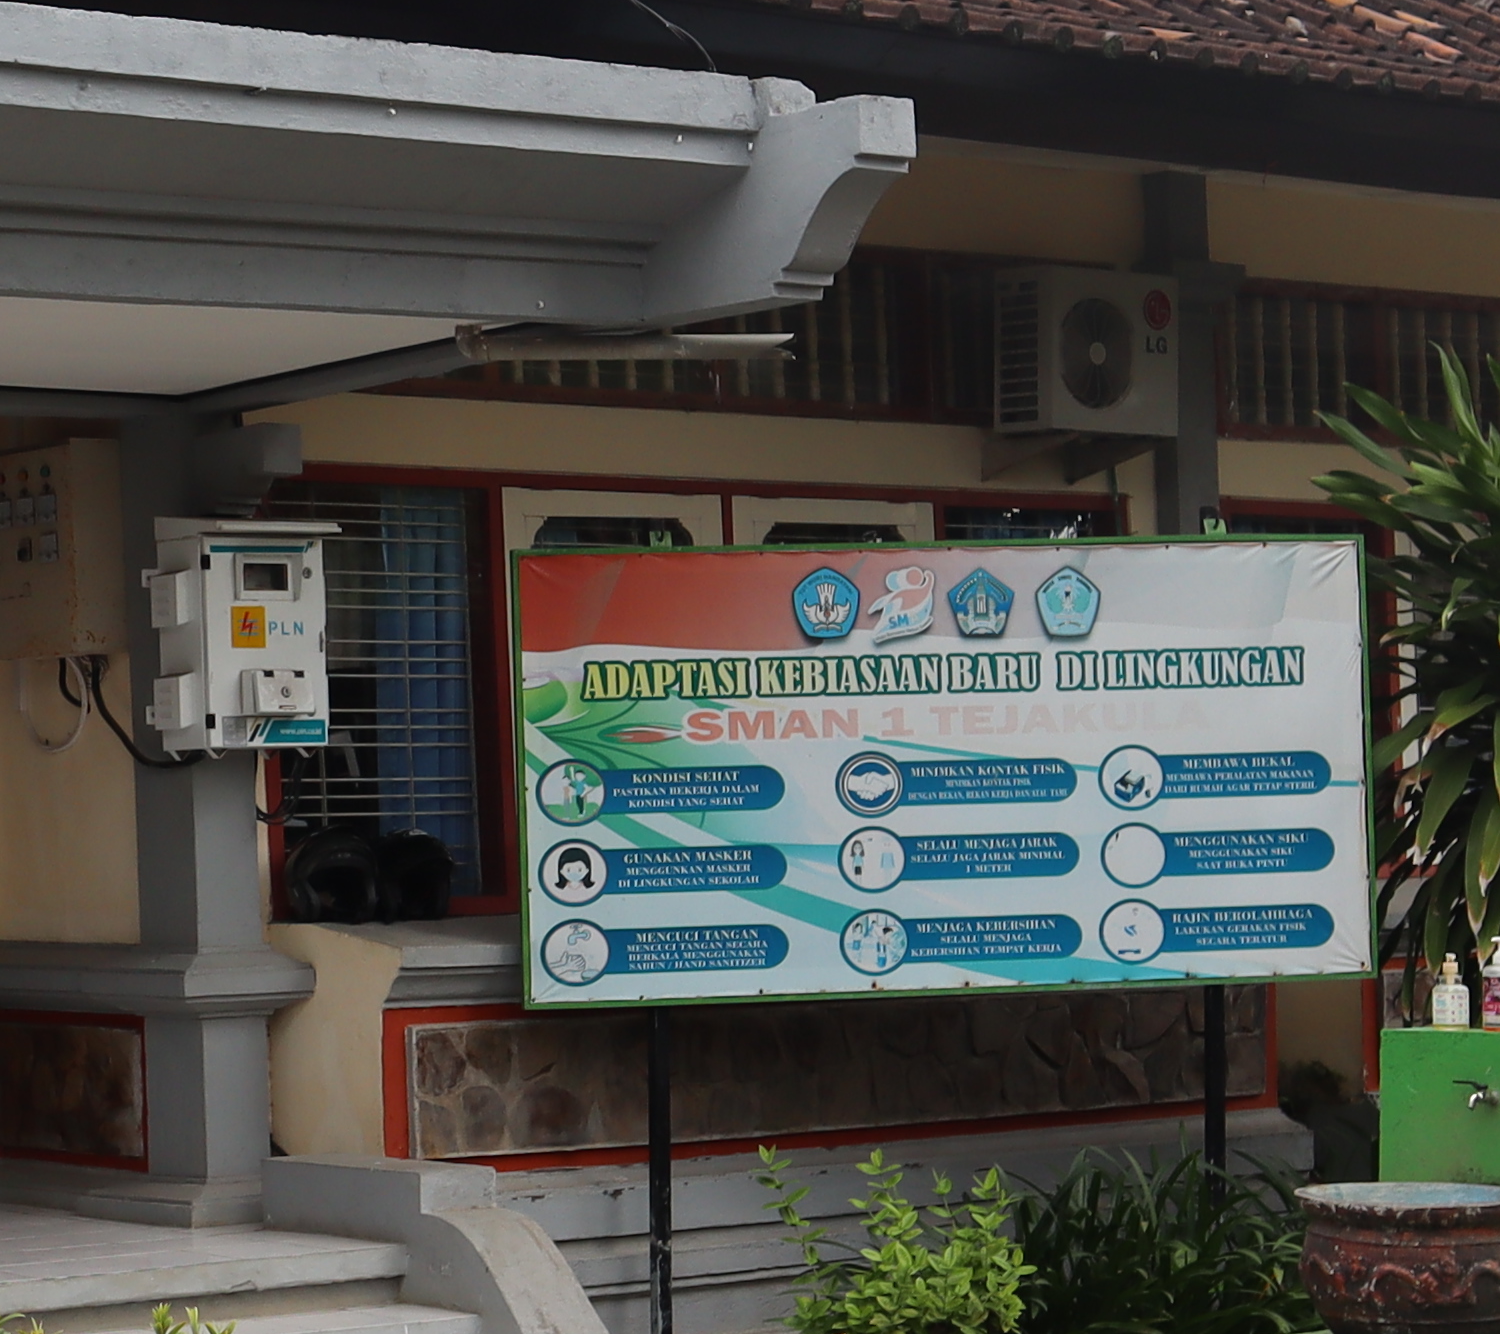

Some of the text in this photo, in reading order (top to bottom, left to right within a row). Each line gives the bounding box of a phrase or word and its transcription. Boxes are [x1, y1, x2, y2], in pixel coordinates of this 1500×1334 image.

[1146, 336, 1168, 355] LG
[268, 621, 304, 635] PLN
[582, 647, 1304, 700] ADAPTASI KEBIASAAN BARU DI LINGKUNGAN
[684, 699, 1210, 742] SMAN 1 TEJAKULA
[1183, 756, 1295, 769] MEMBAWA BEKAL
[632, 771, 740, 783] KONDISI SEHAT
[911, 764, 1065, 777] MINIMKAN KONTAK FISIK
[1166, 770, 1314, 781] MEMBAWA PERALATAN MAKANAN
[613, 784, 759, 797] PASTIKAN BEKERJA DALAM
[1165, 781, 1317, 793] DARI RUMAH AGAR TETAP STERIL
[629, 797, 745, 808] KONDISI YANG SEHAT
[917, 837, 1057, 851] SELALU MENJAGA JARAK
[1174, 833, 1309, 847] MENGGUNAKAN SIKU
[623, 850, 752, 864] GUNAKAN MASKER
[911, 850, 1065, 863] SELALU JAGA JARAK MINIMAL
[1189, 847, 1295, 858] MENGGUNAKAN SIKU
[706, 864, 750, 873] MASKER
[974, 864, 1011, 873] METER
[1197, 859, 1288, 869] SAAT BUKA PINTU
[618, 875, 759, 888] DI LINGKUNGAN SEKOLAH
[1172, 909, 1313, 924] RAJIN BEROLAHRAGA
[917, 919, 1056, 933] MENJAGA KEBERSIHAN
[1175, 922, 1306, 935] LAKUKAN GERAKAN FISIK
[636, 929, 758, 943] MENCUCI TANGAN
[940, 933, 1032, 944] SELALU MENJAGA
[1196, 934, 1287, 946] SECARA TERATUR
[627, 940, 768, 952] MENCUCI TANGAN SECARA
[911, 944, 1061, 957] KEBERSIHAN TEMPAT KERJA
[629, 950, 766, 961] BERKALA MENGGUNAKAN
[629, 961, 666, 970] SABUN
[675, 960, 706, 969] HAND
[709, 958, 765, 967] SANITIZER
